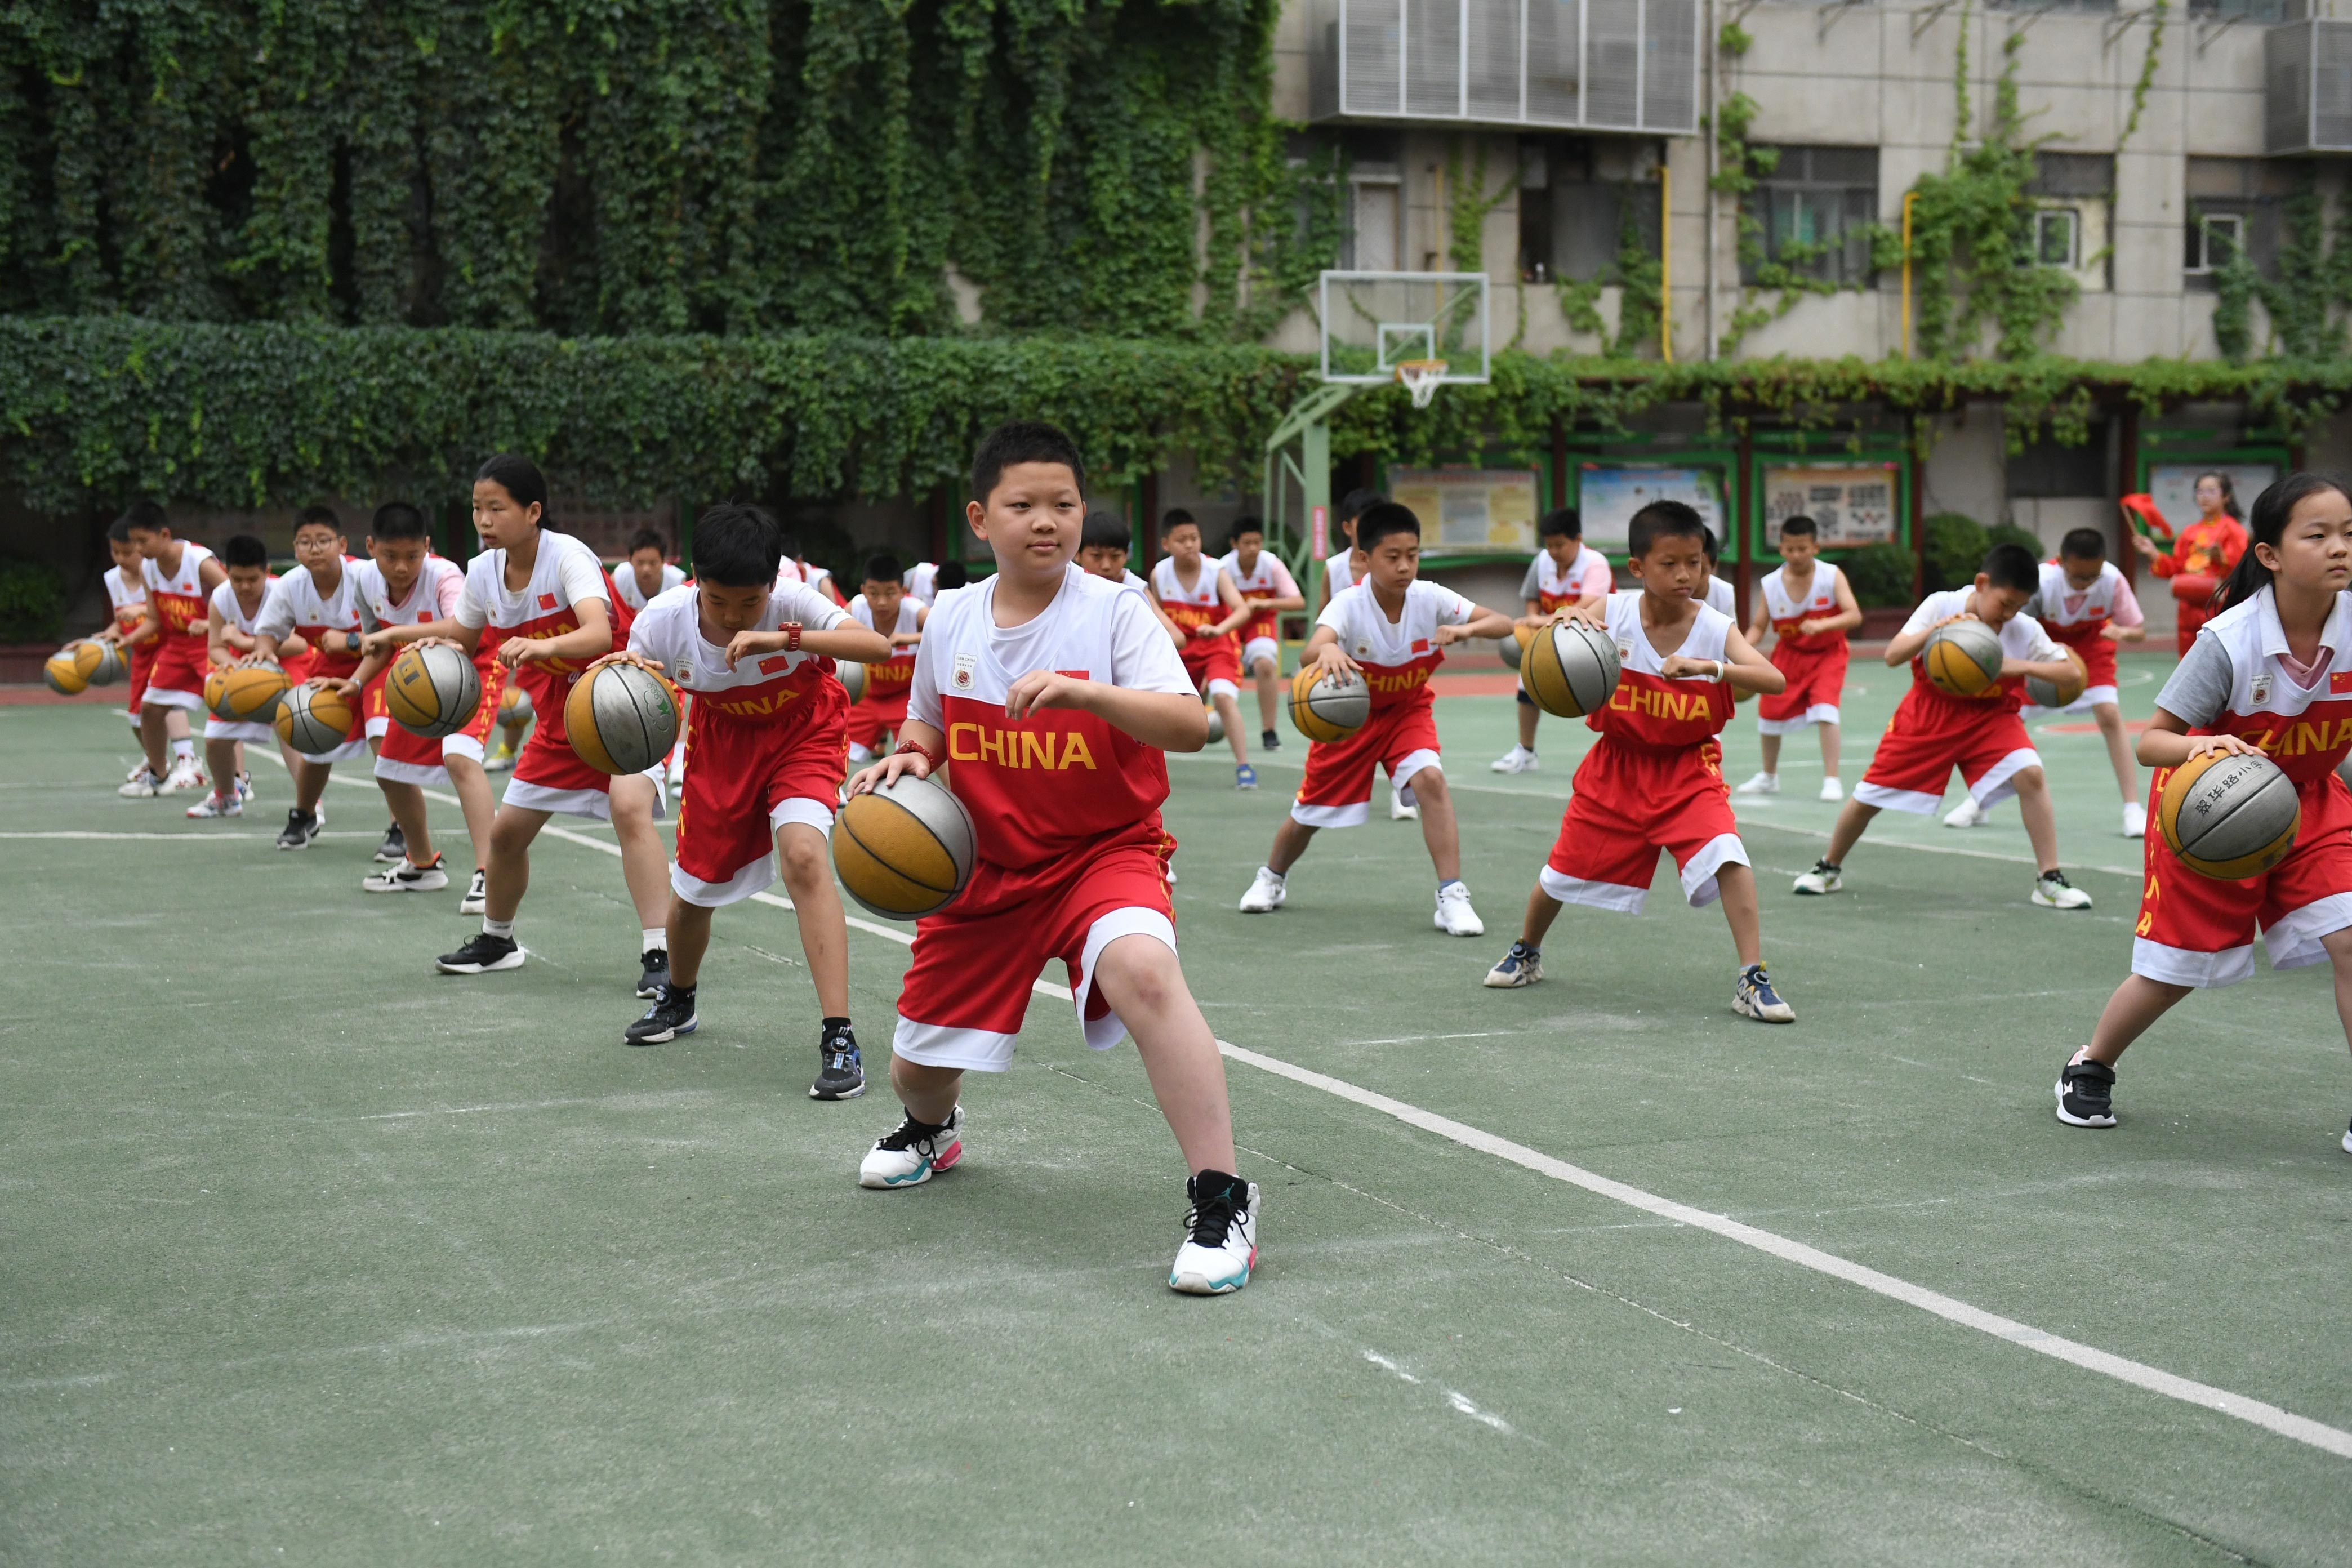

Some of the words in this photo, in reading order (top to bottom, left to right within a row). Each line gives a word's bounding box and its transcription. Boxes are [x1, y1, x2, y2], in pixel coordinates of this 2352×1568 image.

[865, 662, 912, 682] HINA
[1358, 666, 1429, 692] HINA
[1609, 684, 1711, 721] CHINA
[950, 722, 1097, 770] CHINA
[2195, 760, 2263, 816] 翠华路小学
